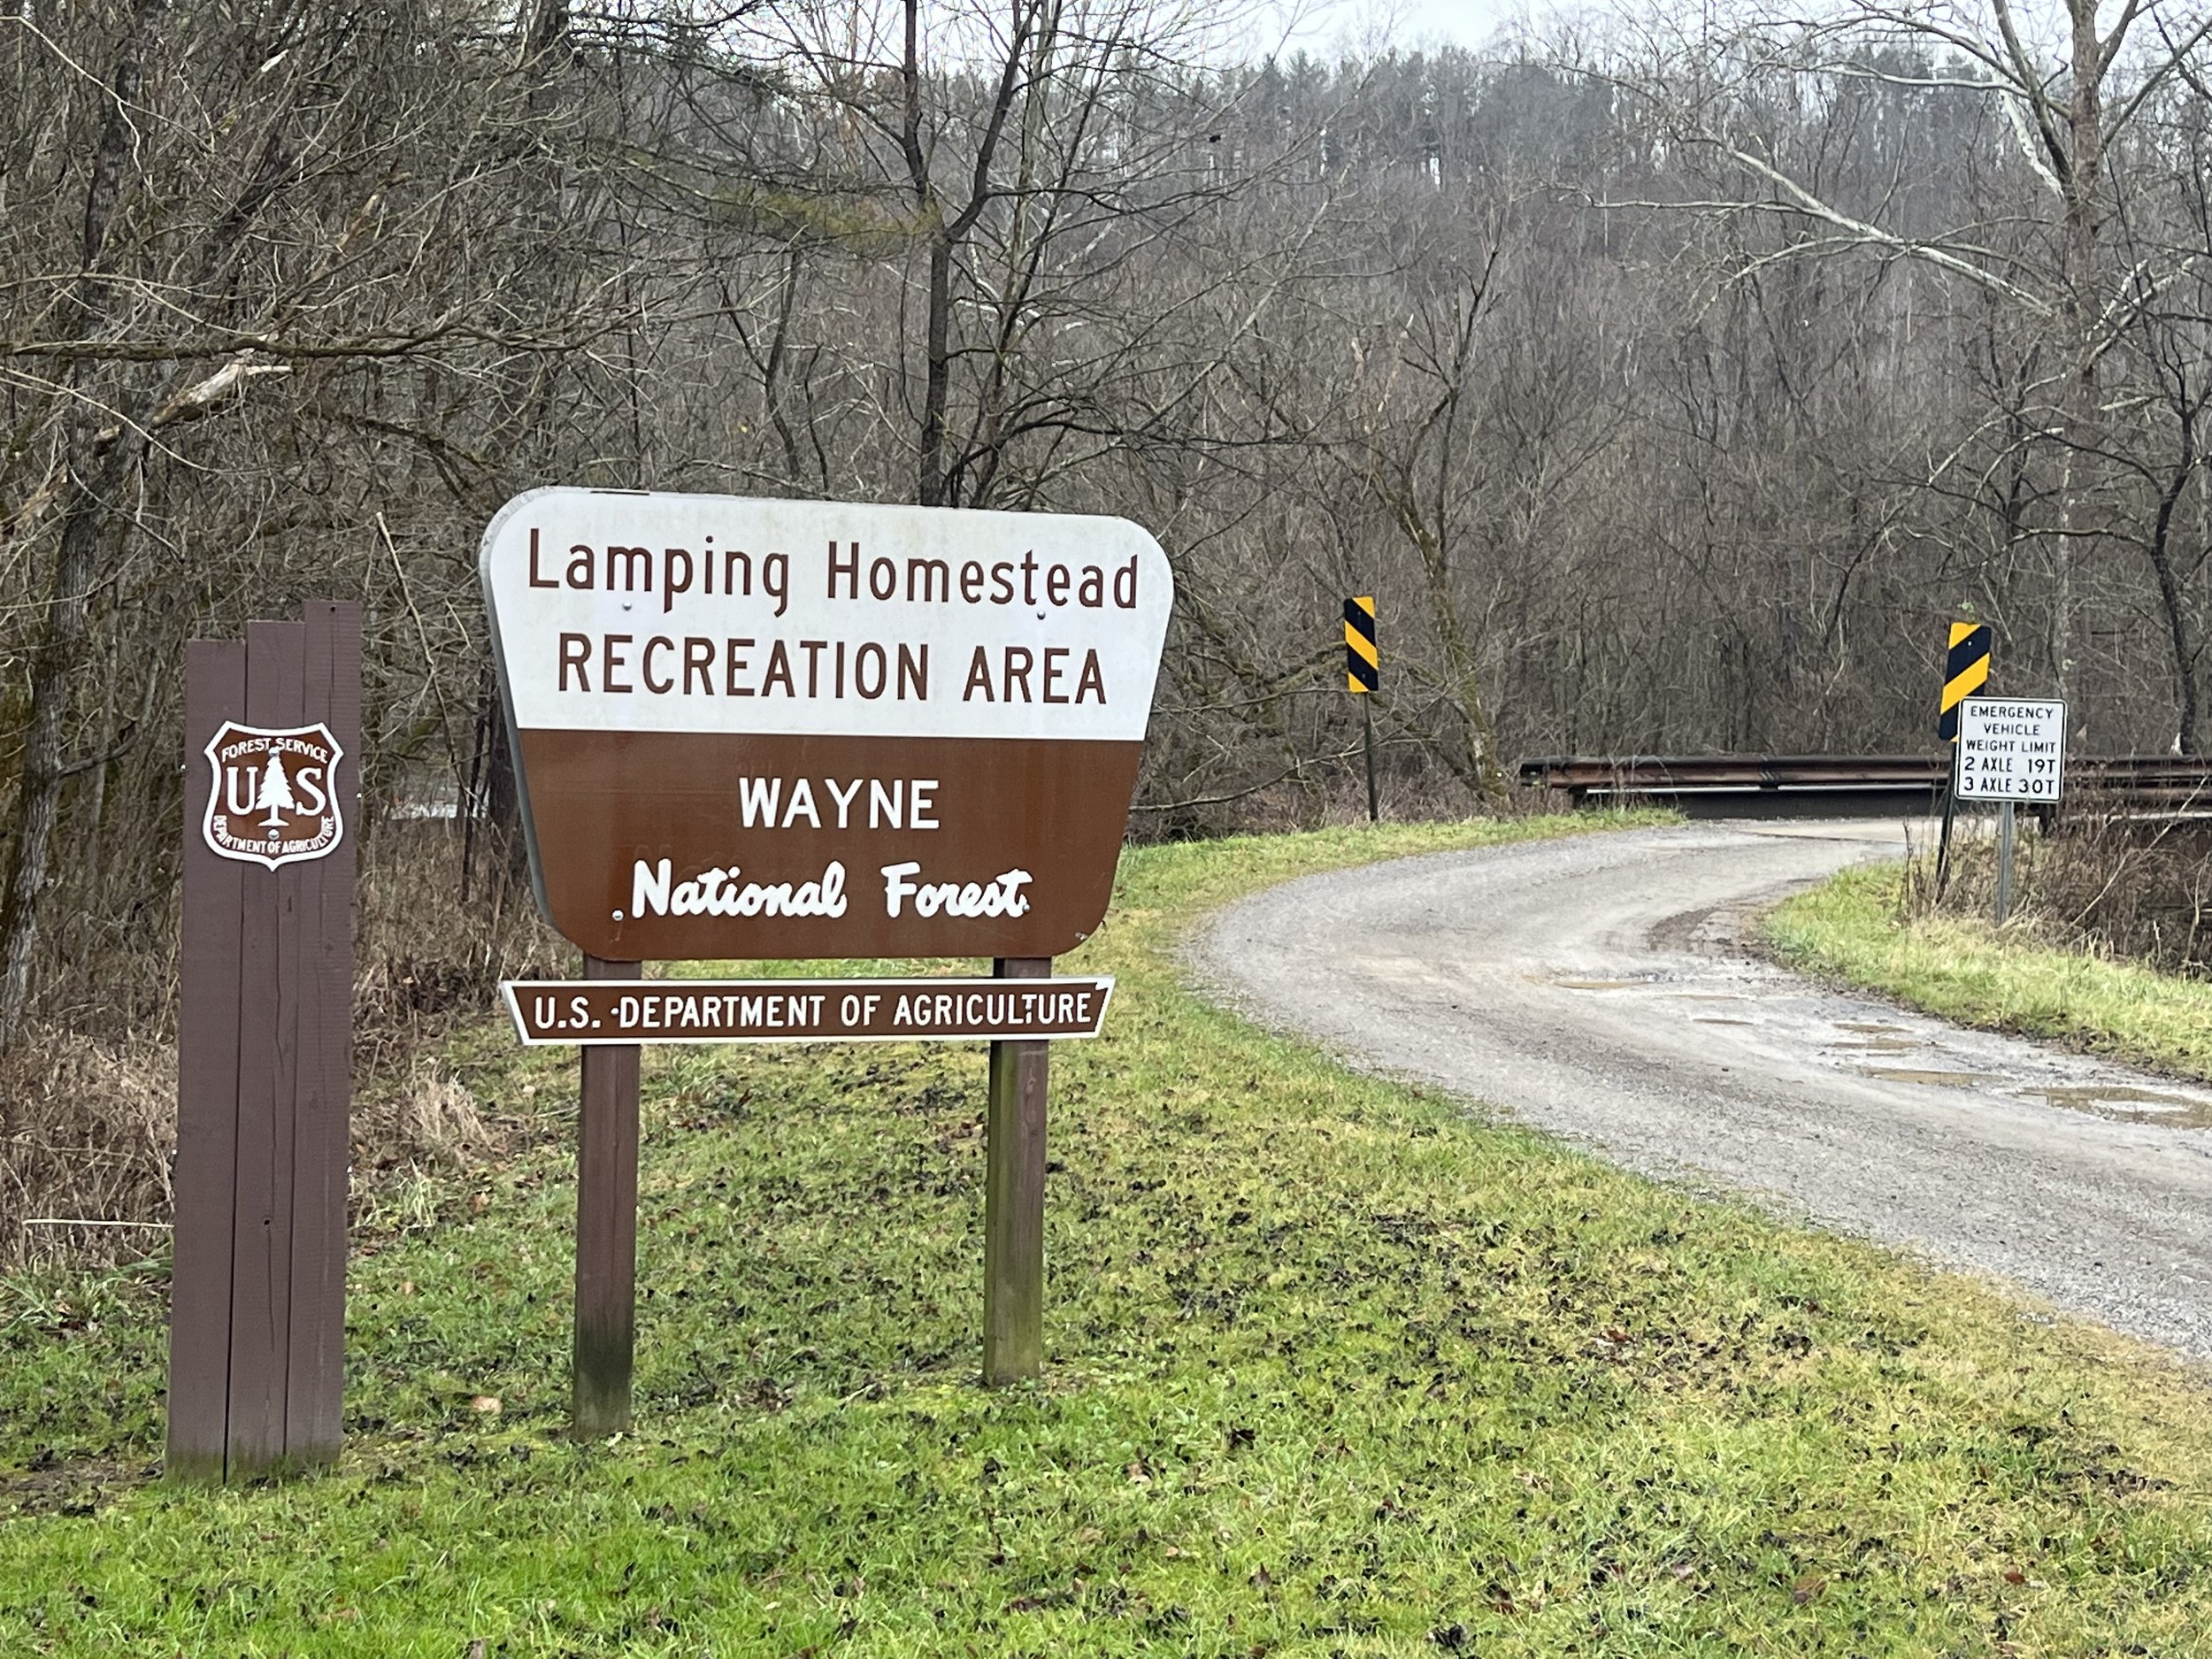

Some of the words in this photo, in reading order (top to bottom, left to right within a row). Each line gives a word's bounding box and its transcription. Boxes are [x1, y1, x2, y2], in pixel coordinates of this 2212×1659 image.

[528, 527, 789, 618] Lamping
[827, 540, 1138, 609] Homestead
[558, 633, 928, 701] RECREATION
[963, 646, 1107, 705] AREA
[1970, 706, 2053, 719] EMERGENCY
[1984, 723, 2039, 735] VEHICLE
[222, 738, 271, 763] FOREST
[276, 738, 328, 763] SERVICE
[1966, 740, 2015, 752] WEIGHT
[2022, 741, 2056, 753] LIMIT
[1964, 757, 1975, 771] 2
[1981, 757, 2013, 772] AXLE
[2028, 758, 2055, 773] 19T
[1964, 777, 1974, 791] 3
[1981, 778, 2011, 792] AXLE
[2018, 779, 2054, 794] 30T
[738, 777, 939, 829] WAYNE
[267, 841, 281, 854] OF
[633, 858, 846, 919] National
[880, 862, 1033, 918] Forest
[534, 996, 600, 1029] U.S.
[619, 996, 825, 1027] DEPARTMENT
[841, 995, 877, 1025] OF
[894, 992, 1092, 1025] AGRICULTURE
